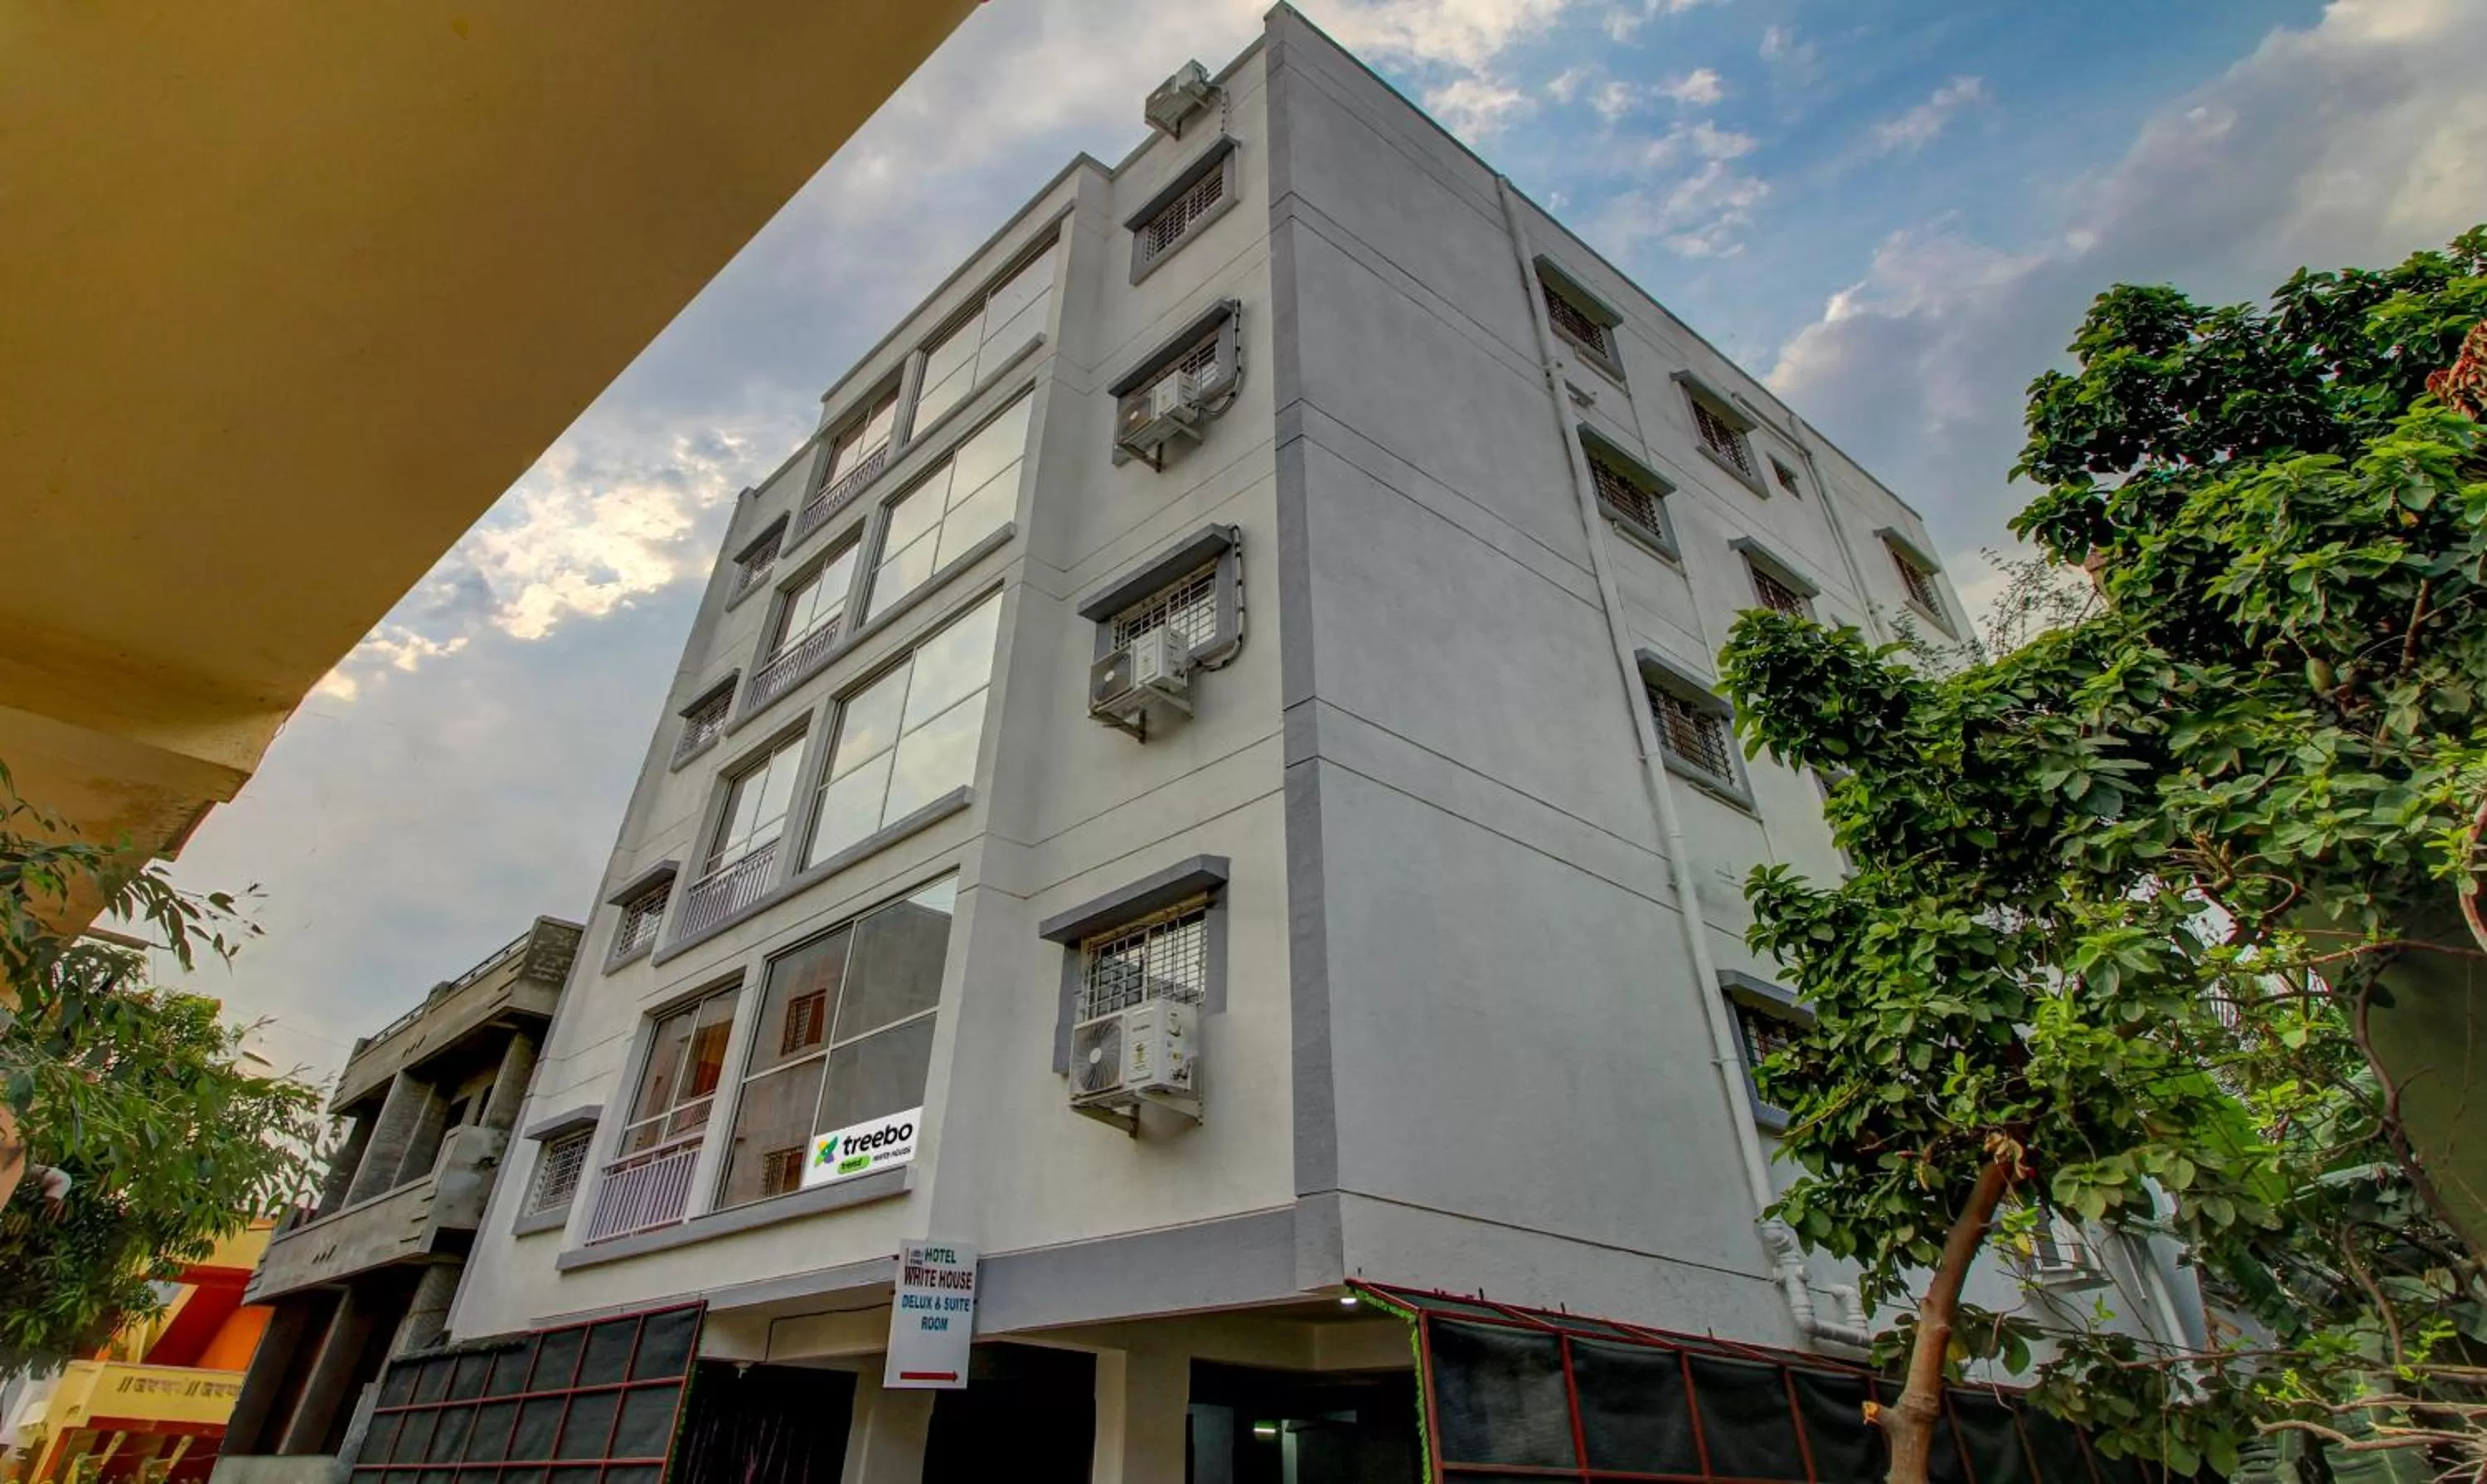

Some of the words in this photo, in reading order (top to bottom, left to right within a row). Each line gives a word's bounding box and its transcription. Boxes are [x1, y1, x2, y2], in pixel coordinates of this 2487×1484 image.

[842, 1123, 913, 1156] treebo
[925, 1248, 957, 1263] HOTEL
[904, 1266, 937, 1288] WHITE
[938, 1269, 972, 1290] HOUSE
[901, 1294, 933, 1309] DELUX
[943, 1297, 971, 1312] SUITE
[921, 1316, 949, 1331] ROOM
